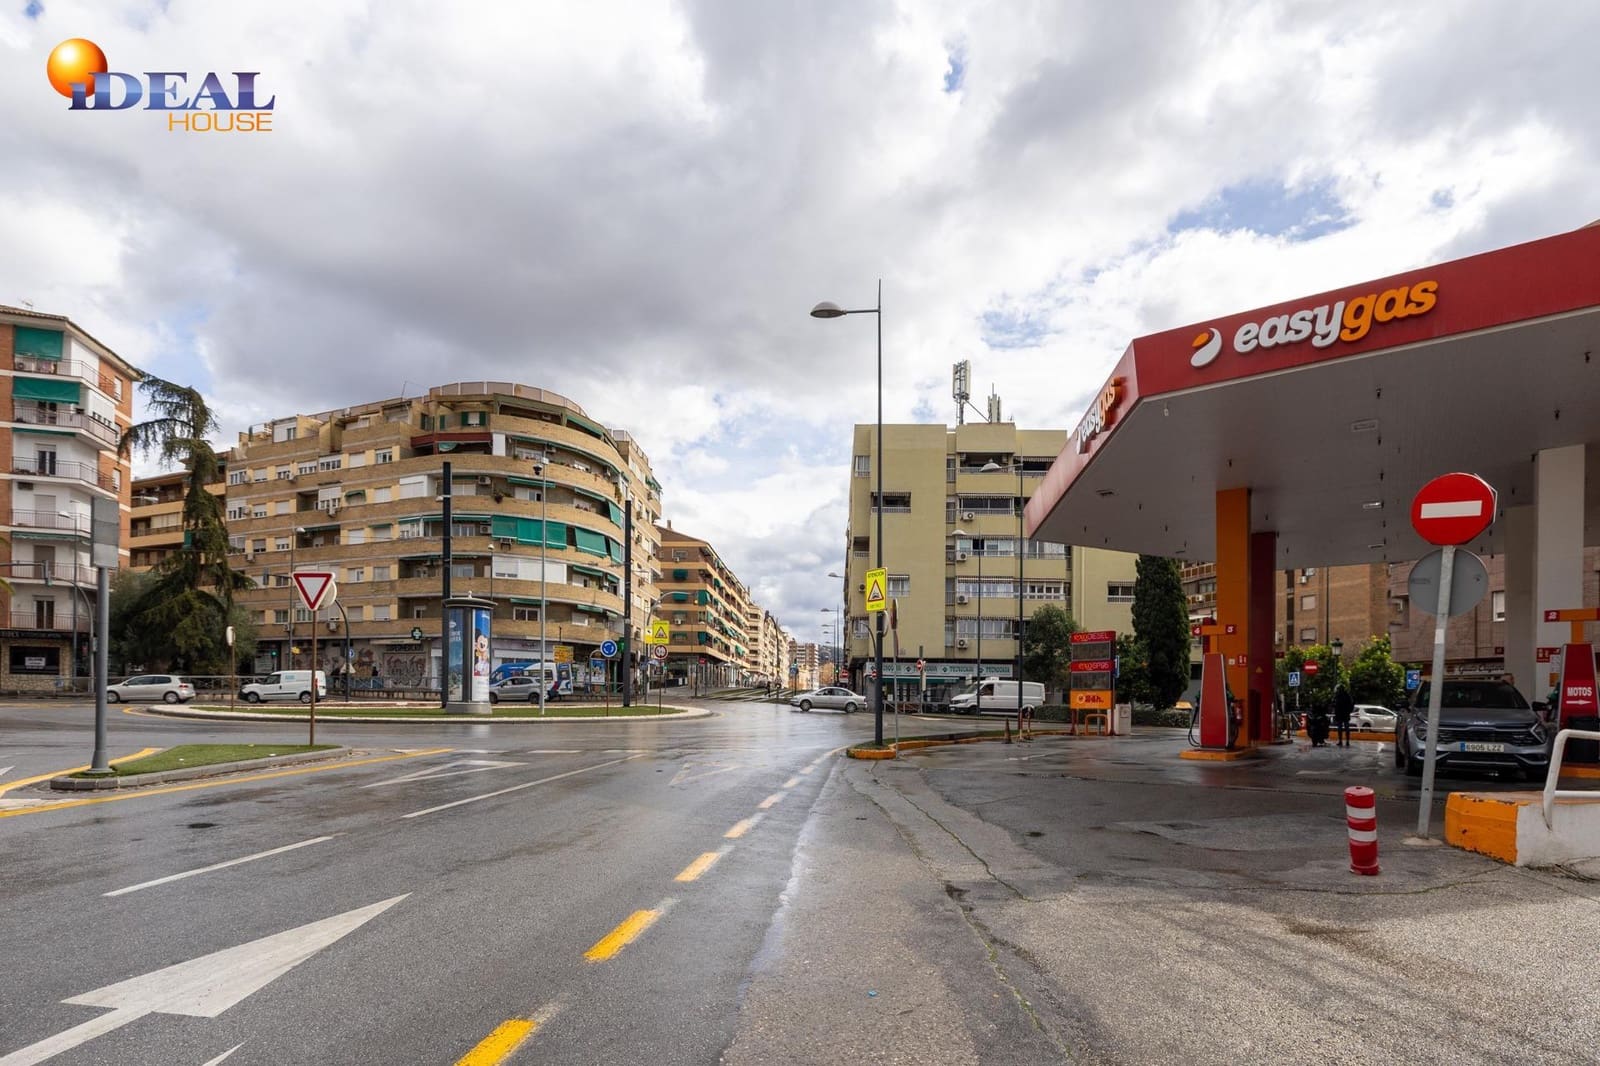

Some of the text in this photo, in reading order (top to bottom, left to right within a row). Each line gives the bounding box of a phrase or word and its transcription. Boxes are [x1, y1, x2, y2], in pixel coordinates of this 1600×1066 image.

[1233, 280, 1438, 353] easygas
[1081, 376, 1121, 442] easygas
[1567, 686, 1593, 697] MOTOS
